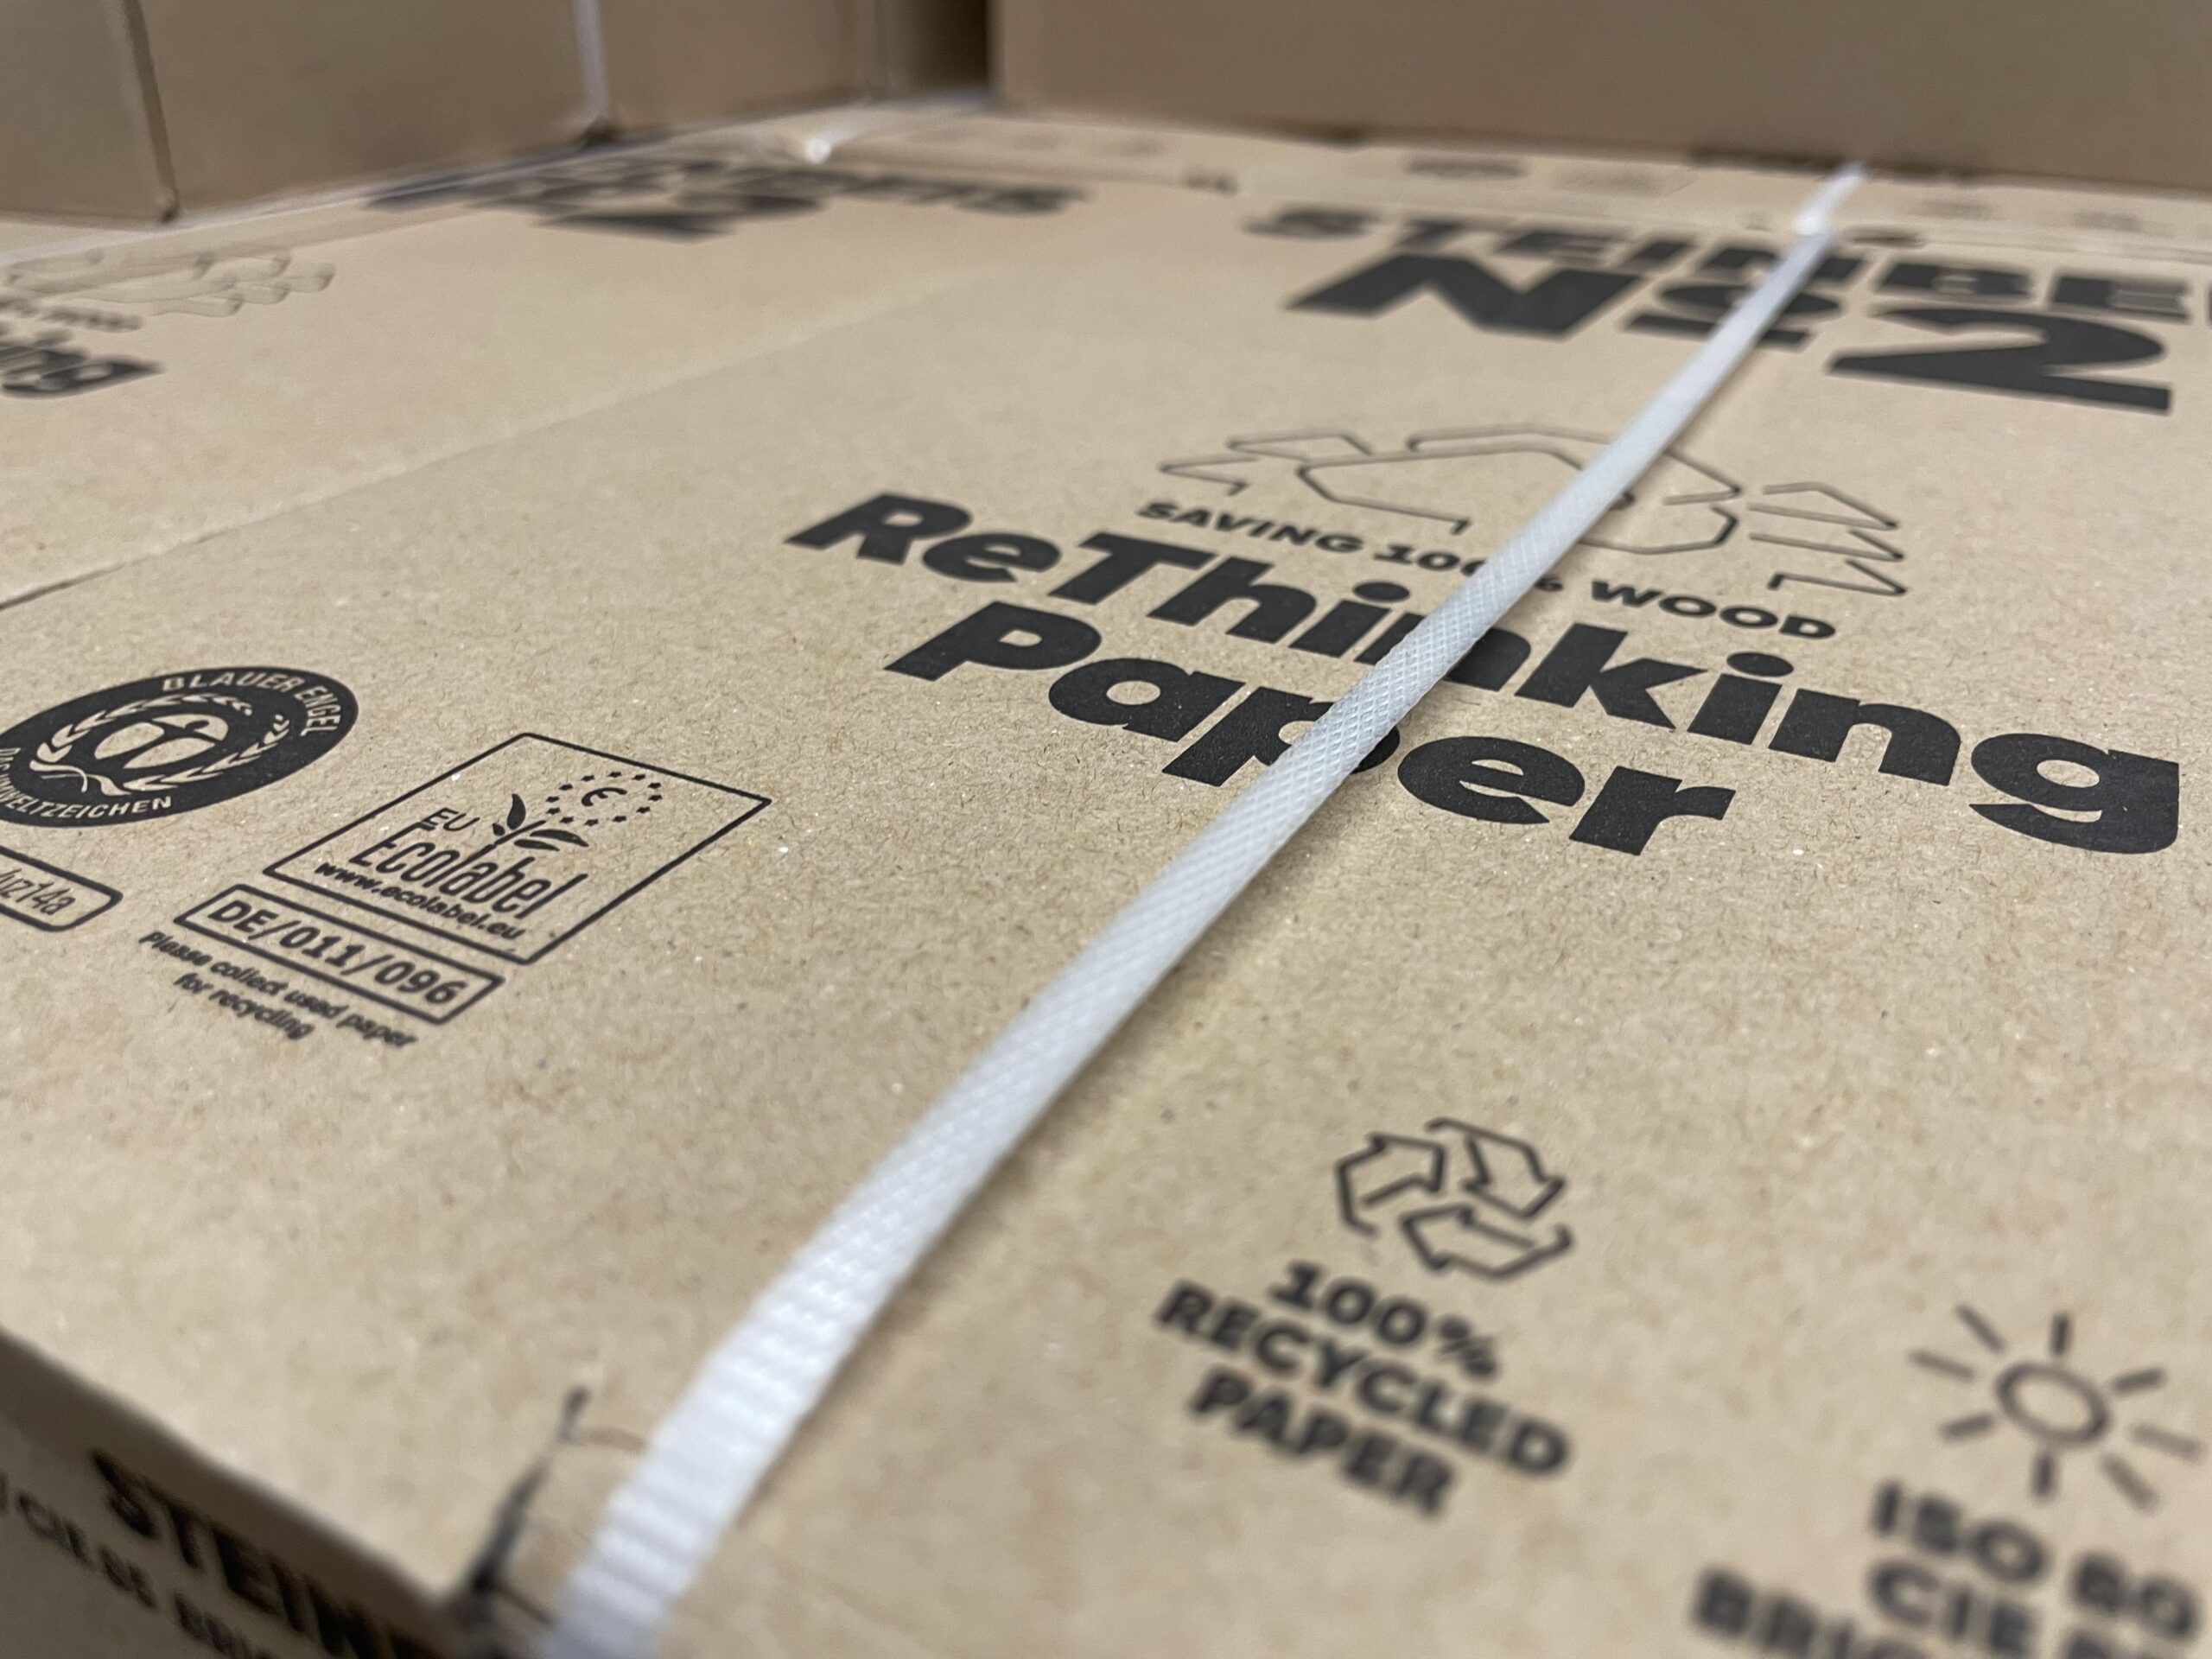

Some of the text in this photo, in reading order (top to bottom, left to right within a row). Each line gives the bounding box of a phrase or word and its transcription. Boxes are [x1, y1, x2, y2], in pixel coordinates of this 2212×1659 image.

[1244, 207, 2212, 325] STEINBE
[1135, 501, 1363, 553] SAVING
[1591, 578, 1836, 640] WOOD
[162, 671, 341, 737] BLAUER ENGEL
[782, 493, 2180, 855] ReThinking
[882, 601, 1736, 856] Paper
[348, 821, 588, 918] Ecolabel
[419, 807, 480, 832] EU
[207, 899, 467, 1004] DE/011/096
[315, 863, 526, 940] www.ecolabel.eu
[138, 931, 417, 1047] Please collect used paper
[175, 972, 315, 1039] for recycling
[1268, 1262, 1500, 1379] 100%
[1154, 1281, 1571, 1478] RECYCLED
[1189, 1365, 1457, 1519] PAPER
[1869, 1478, 2053, 1588] ISO
